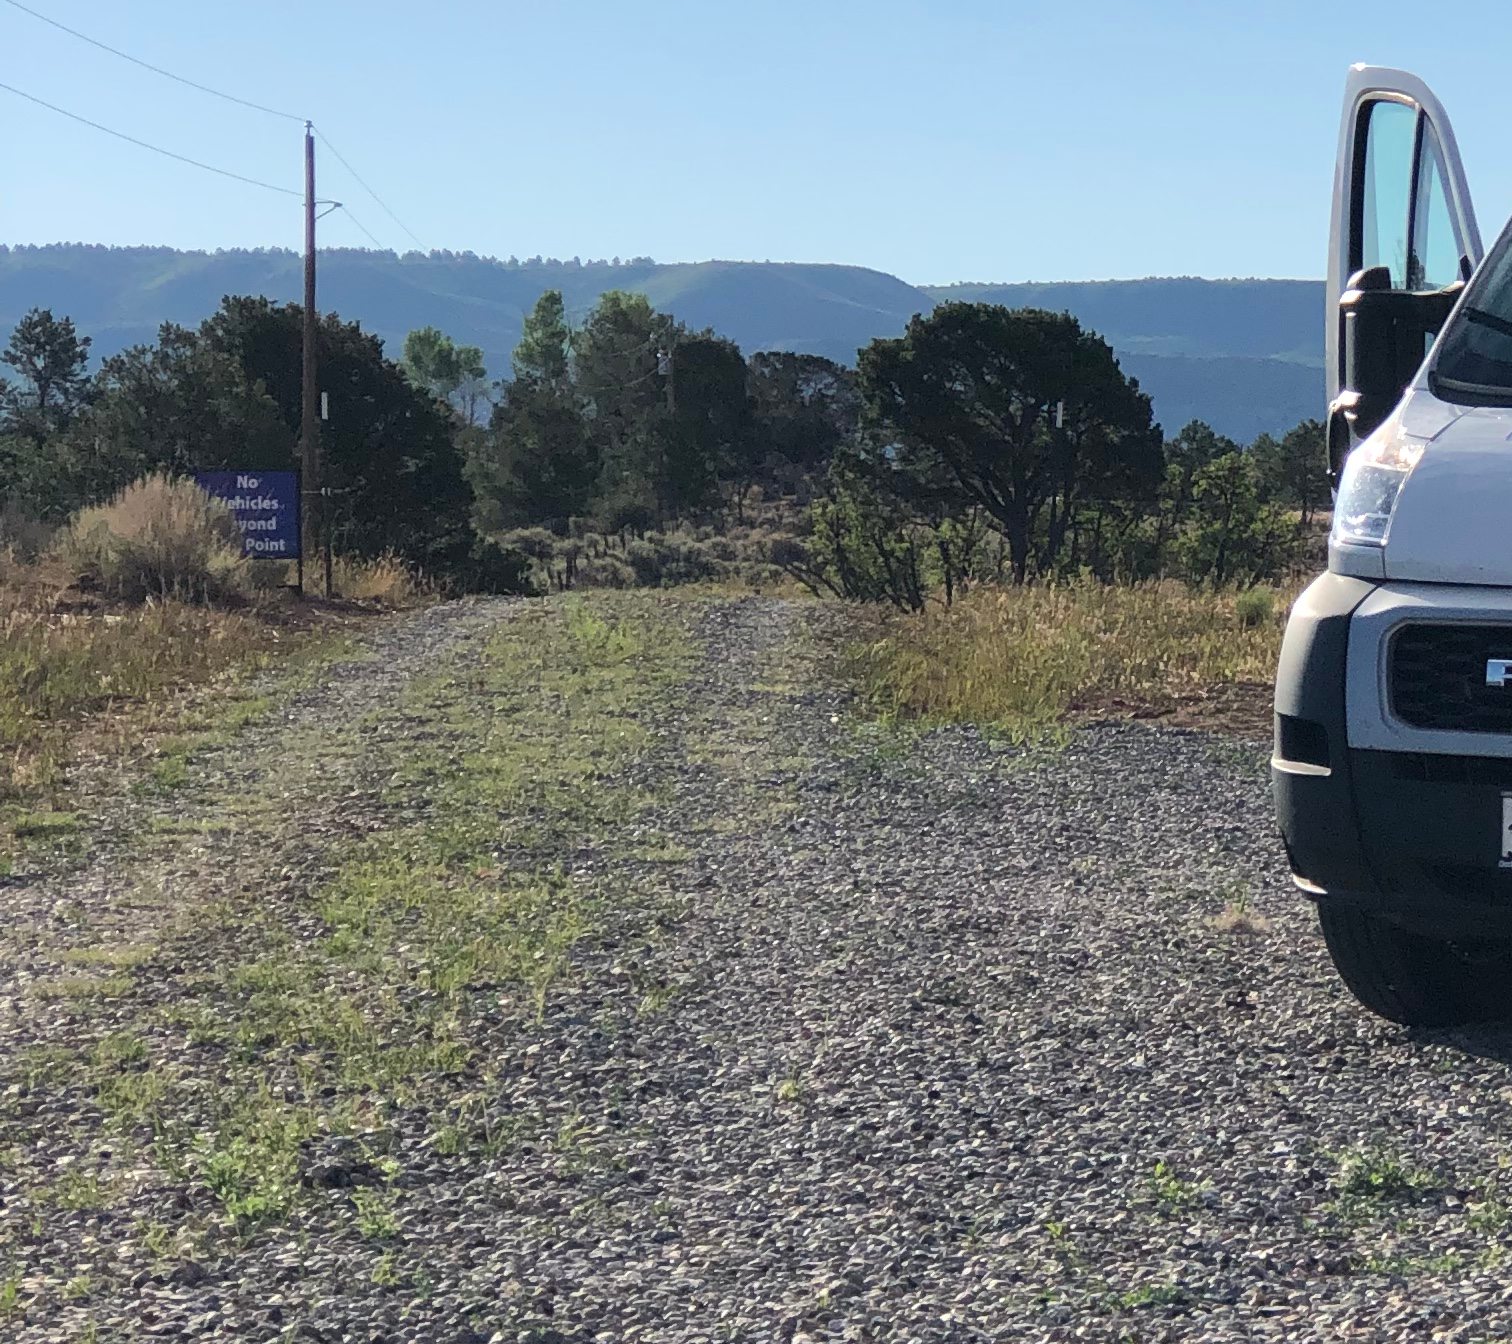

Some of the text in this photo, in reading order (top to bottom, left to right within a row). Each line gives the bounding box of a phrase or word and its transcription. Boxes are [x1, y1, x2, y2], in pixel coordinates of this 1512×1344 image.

[237, 475, 259, 488] No
[234, 516, 277, 533] yond
[245, 538, 286, 551] Point
